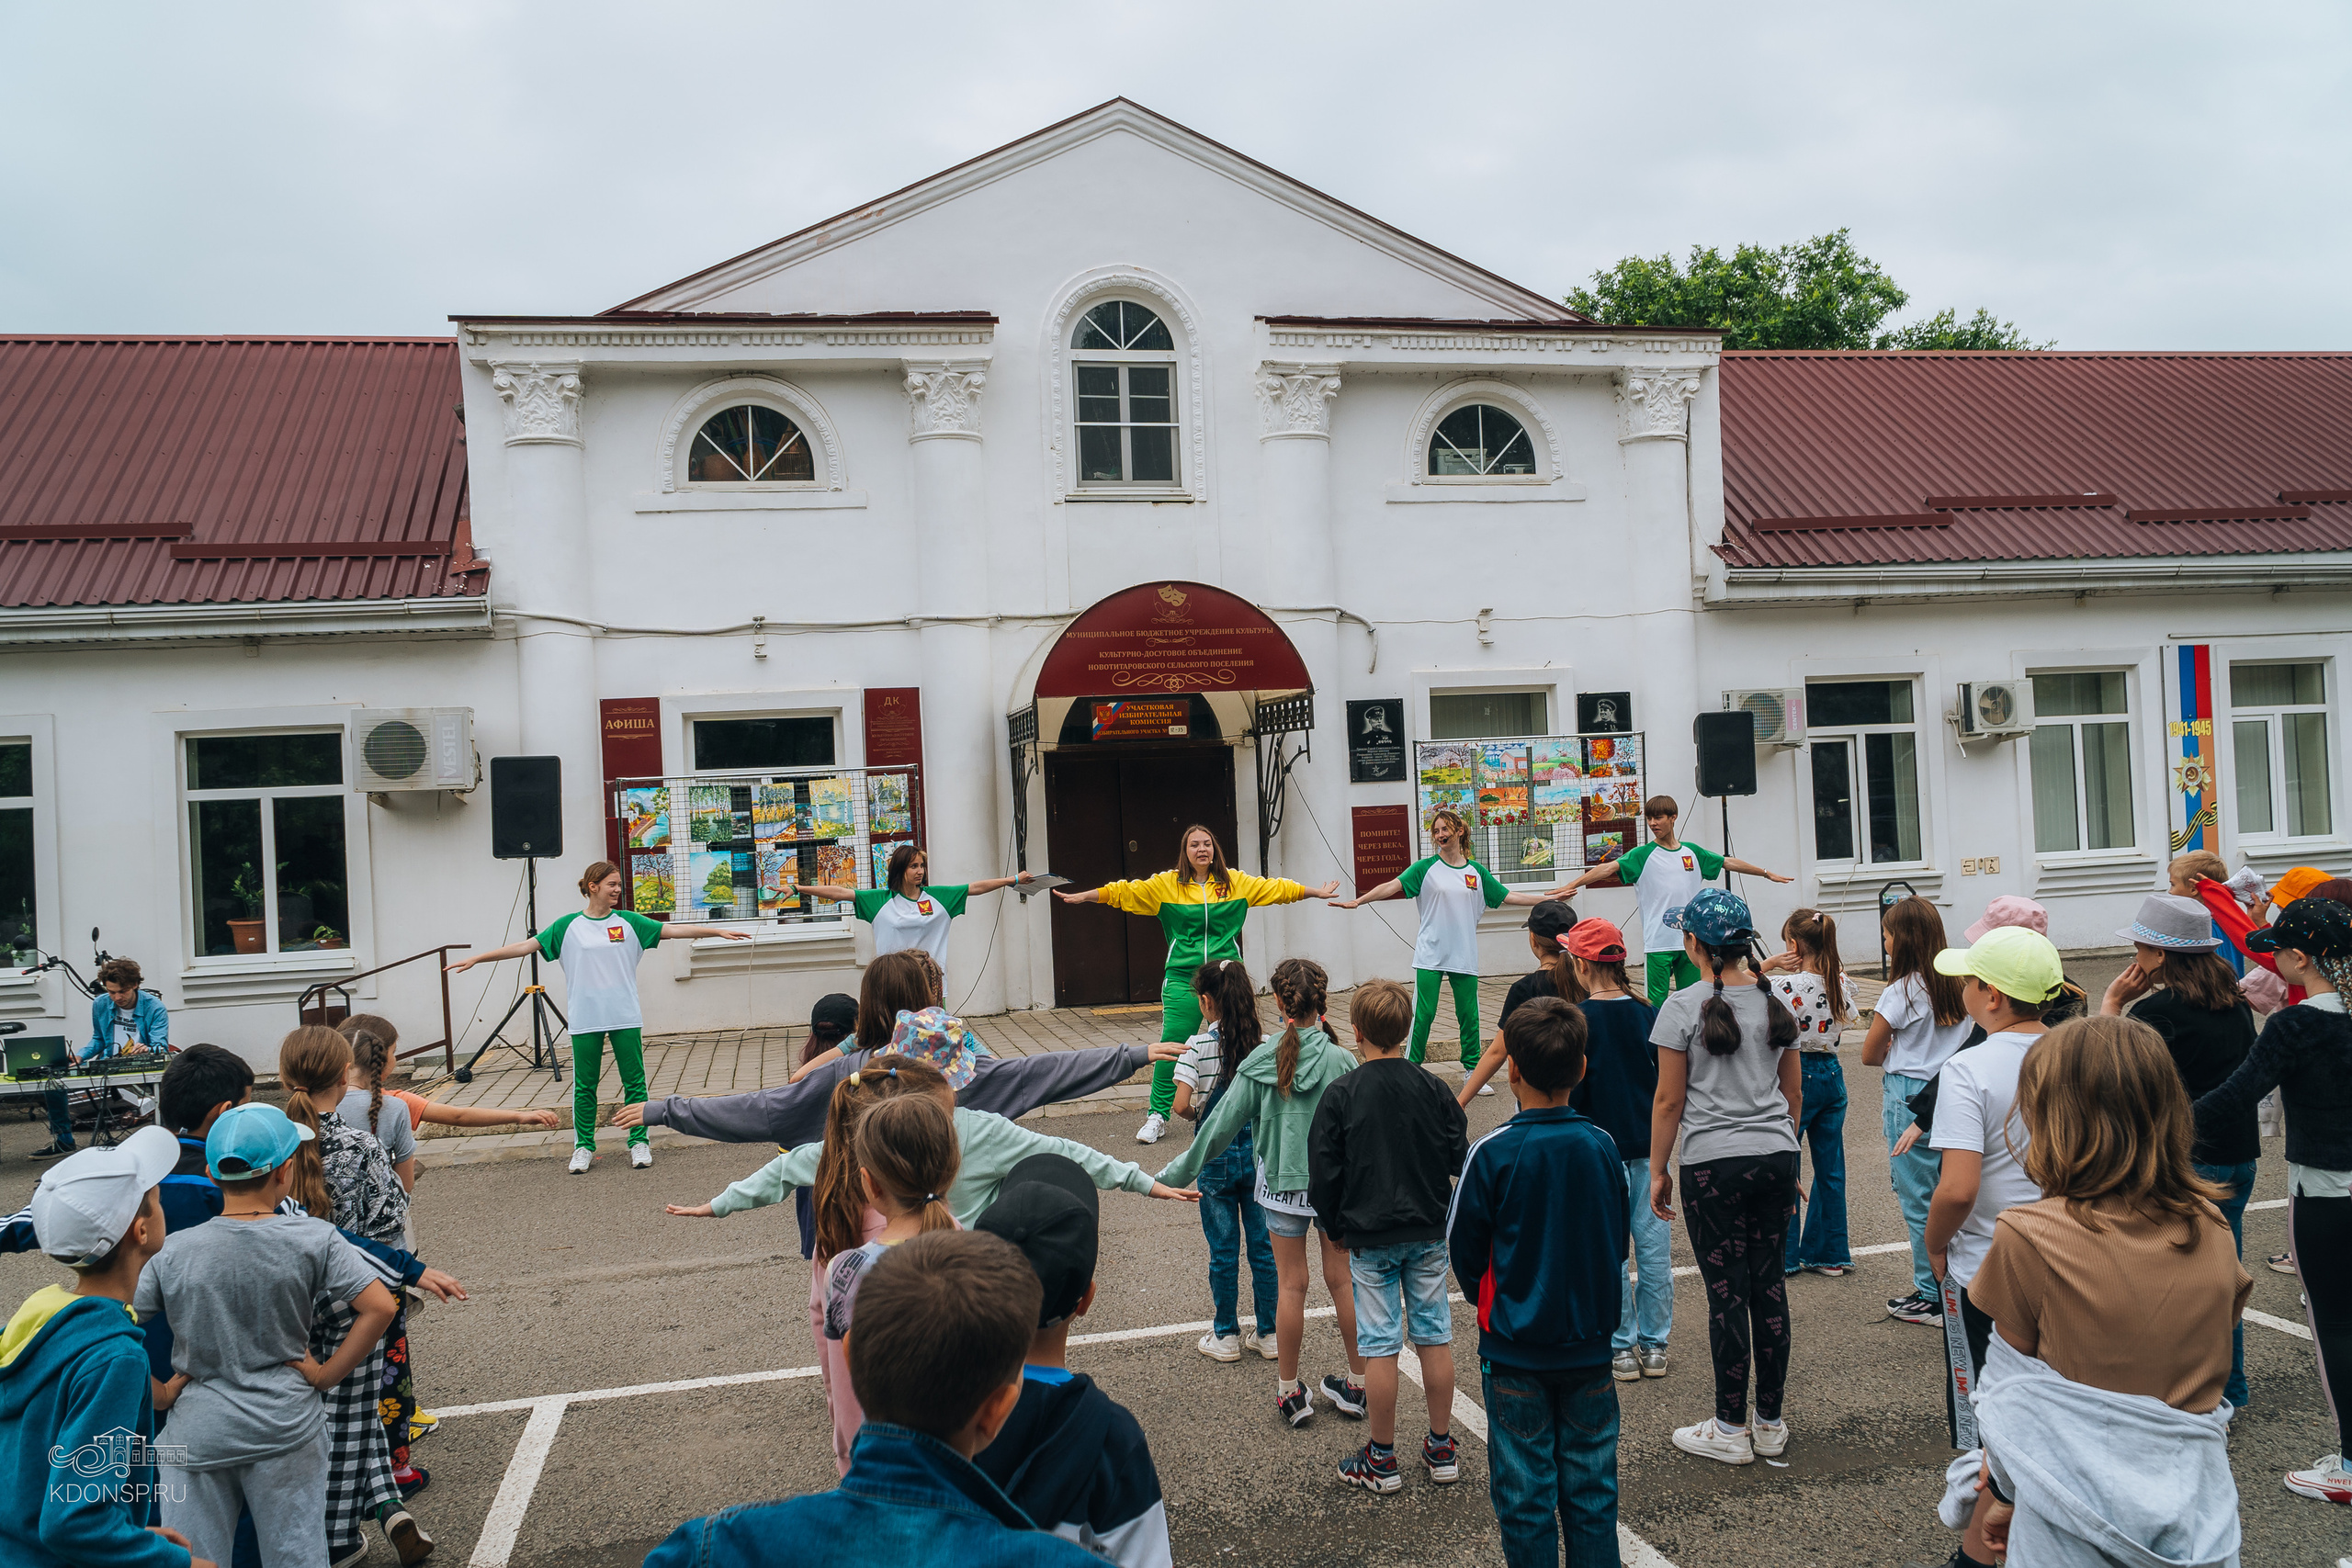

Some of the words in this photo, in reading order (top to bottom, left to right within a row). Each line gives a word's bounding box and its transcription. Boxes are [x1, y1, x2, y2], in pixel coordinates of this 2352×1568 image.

[1066, 631, 1136, 639] МУНИЦИПАЛЬНОЕ
[1136, 629, 1184, 638] БЮДЖЕТНОЕ
[1184, 627, 1235, 637] УЧРЕЖДЕНИЕ
[1236, 626, 1273, 635] КУЛЬТУРЫ
[1099, 649, 1187, 659] КУЛЬТУРНО-ДОСУГОВОЕ
[1187, 648, 1243, 657] ОБЪЕДИНЕНИЕ
[1088, 662, 1166, 671] НОВОТИТАРОВСКОГО
[1167, 661, 1209, 670] СЕЛЬСКОГО
[1210, 660, 1254, 668] ПОСЕЛЕНИЯ
[884, 696, 899, 706] ДК
[1125, 704, 1174, 712] УЧАСТКОВАЯ
[1119, 711, 1182, 719] ИЗБИРАТЕЛЬНАЯ
[605, 718, 655, 730] АФИША
[2168, 719, 2212, 738] 1941-1945
[442, 722, 458, 777] VESTEL
[1360, 829, 1401, 838] ПОМНИТЕ!
[1356, 854, 1380, 863] ЧЕРЕЗ
[1362, 866, 1403, 875] ПОМНИТЕ!
[1712, 1279, 1728, 1289] NEVER
[1765, 1315, 1782, 1324] NEVER
[1959, 1415, 1973, 1449] NEW
